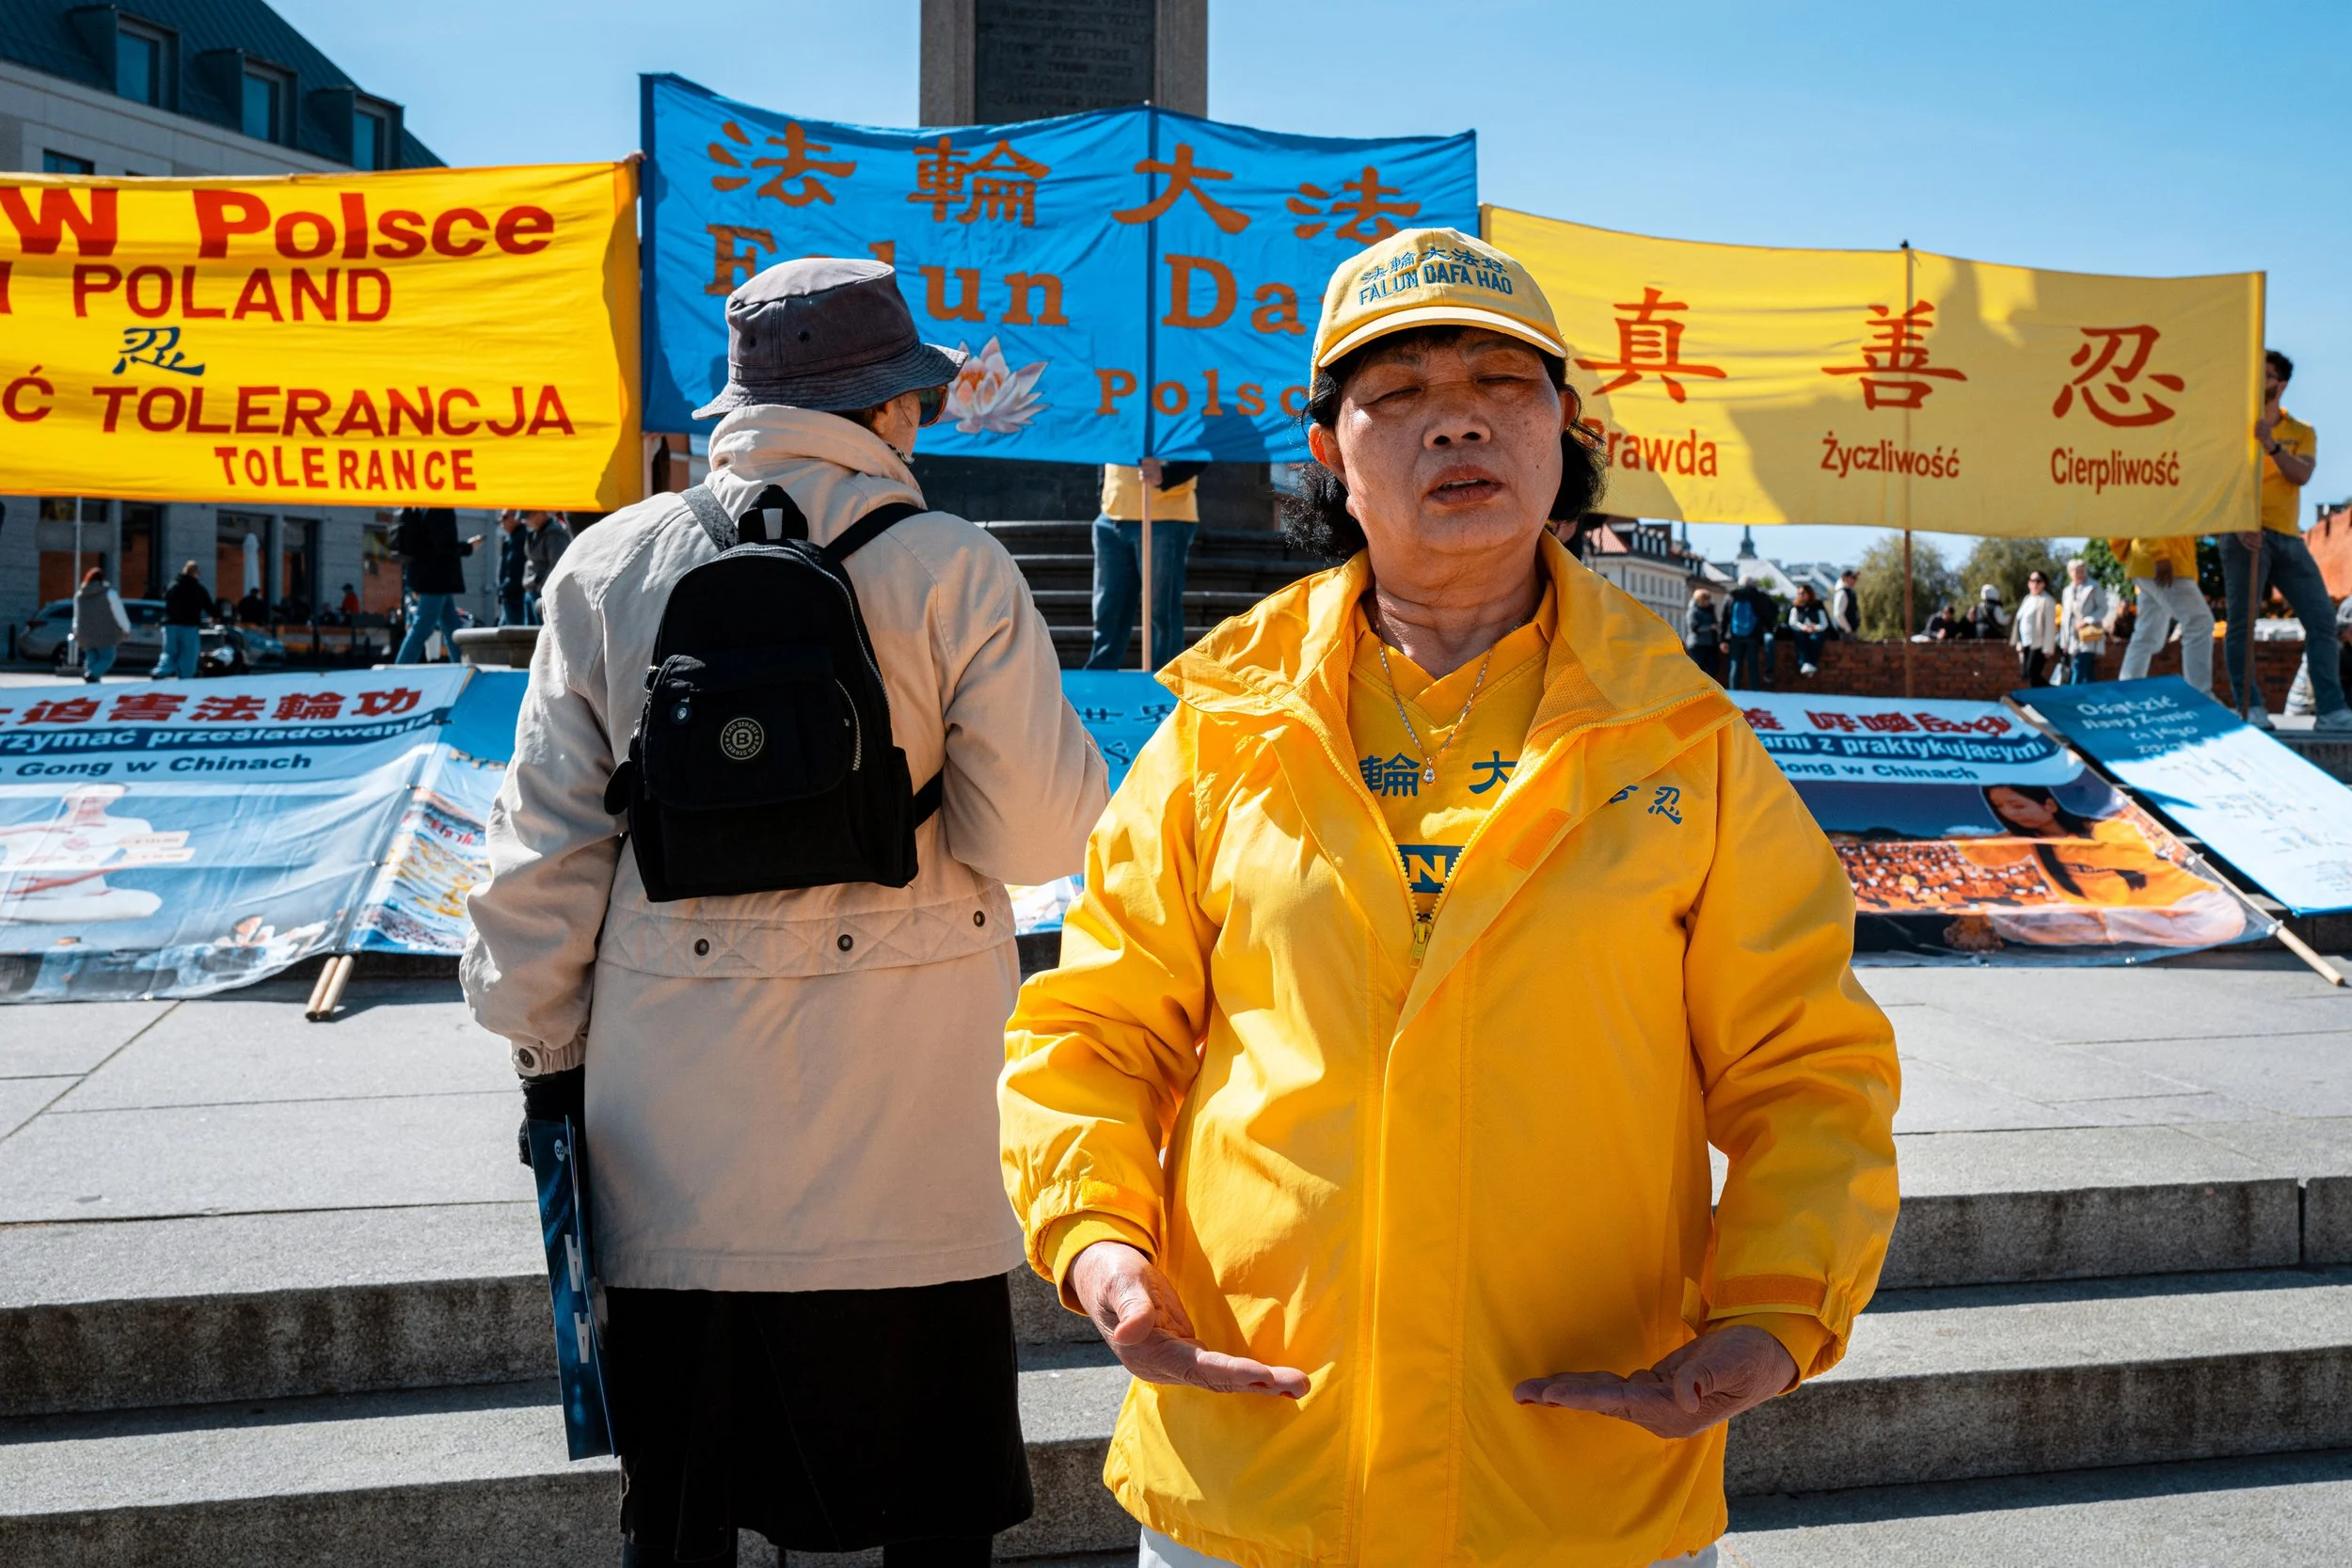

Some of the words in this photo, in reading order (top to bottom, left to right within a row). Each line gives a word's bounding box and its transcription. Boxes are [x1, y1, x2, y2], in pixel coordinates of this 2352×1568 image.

[0, 186, 119, 257] W
[192, 189, 555, 260] Polsce
[1359, 268, 1420, 306] FALUN
[1422, 262, 1474, 285] DAFA
[1476, 270, 1513, 295] HAO
[1360, 246, 1507, 284] 法輪大法好
[72, 264, 392, 322] POLAND
[1574, 287, 1727, 404] 真
[1821, 300, 1968, 411] 善
[2052, 325, 2185, 428] 忍
[92, 386, 575, 437] TOLERANCJA
[215, 446, 478, 491] TOLERANCE
[1821, 431, 1960, 479] Życzliwość
[2051, 447, 2180, 495] Cierpliwość
[0, 687, 422, 725] 迫害法輪功
[147, 712, 434, 748] prześladowania
[1817, 737, 1836, 752] z
[1841, 736, 2047, 761] praktykującymi
[16, 762, 113, 777] Gong
[126, 760, 158, 772] w
[169, 753, 311, 771] Chinach
[1840, 764, 1865, 776] w
[1871, 762, 1979, 780] Chinach
